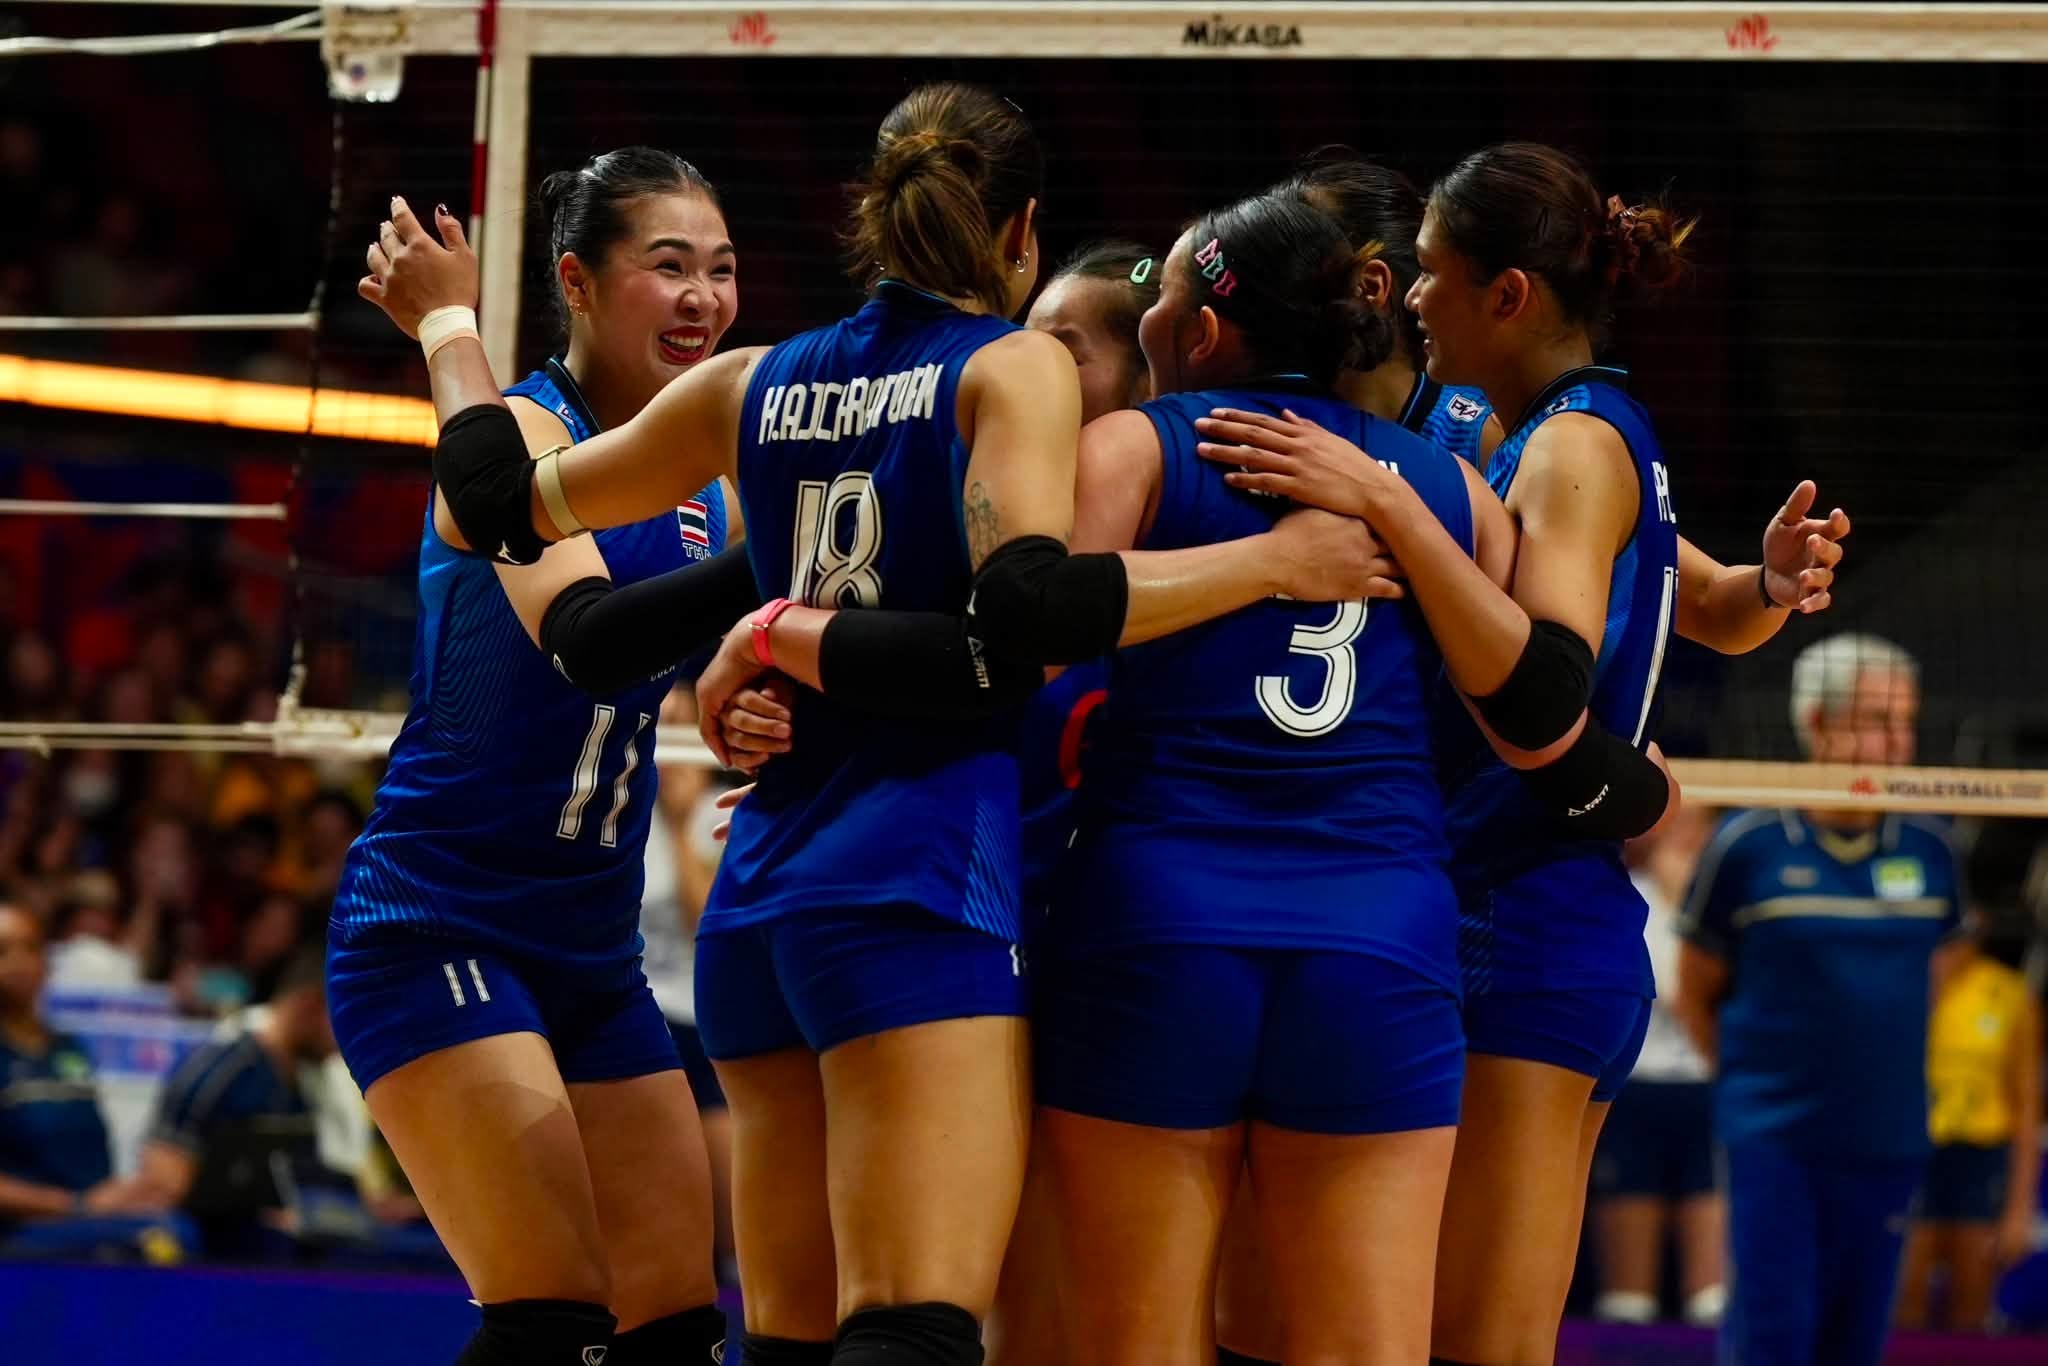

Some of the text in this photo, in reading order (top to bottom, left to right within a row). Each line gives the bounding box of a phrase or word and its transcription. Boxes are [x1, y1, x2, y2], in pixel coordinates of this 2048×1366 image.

[788, 470, 883, 611] 18
[1254, 593, 1369, 737] 3
[556, 703, 651, 848] 11
[442, 959, 491, 1007] 11
